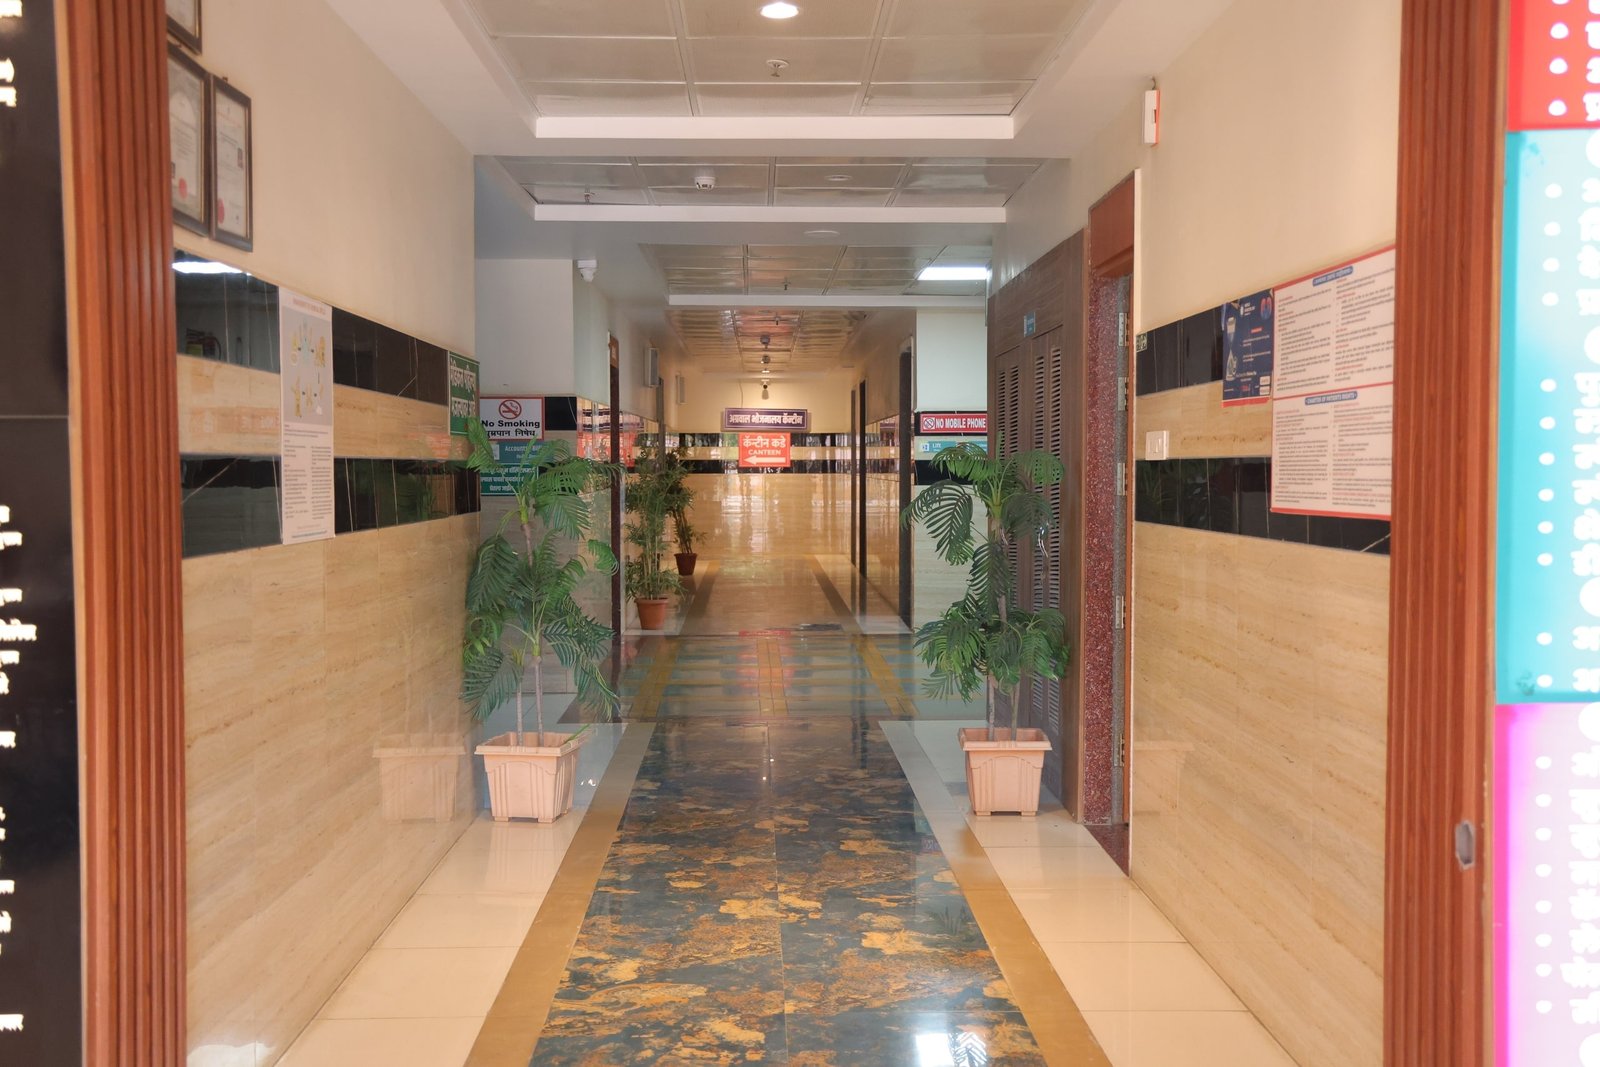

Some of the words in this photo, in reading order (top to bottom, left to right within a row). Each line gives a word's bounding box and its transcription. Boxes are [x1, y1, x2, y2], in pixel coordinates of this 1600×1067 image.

[498, 420, 540, 428] Smoking
[935, 418, 944, 428] NO
[945, 418, 966, 428] MOBILE
[967, 418, 986, 428] PHONE
[771, 435, 786, 448] कडे
